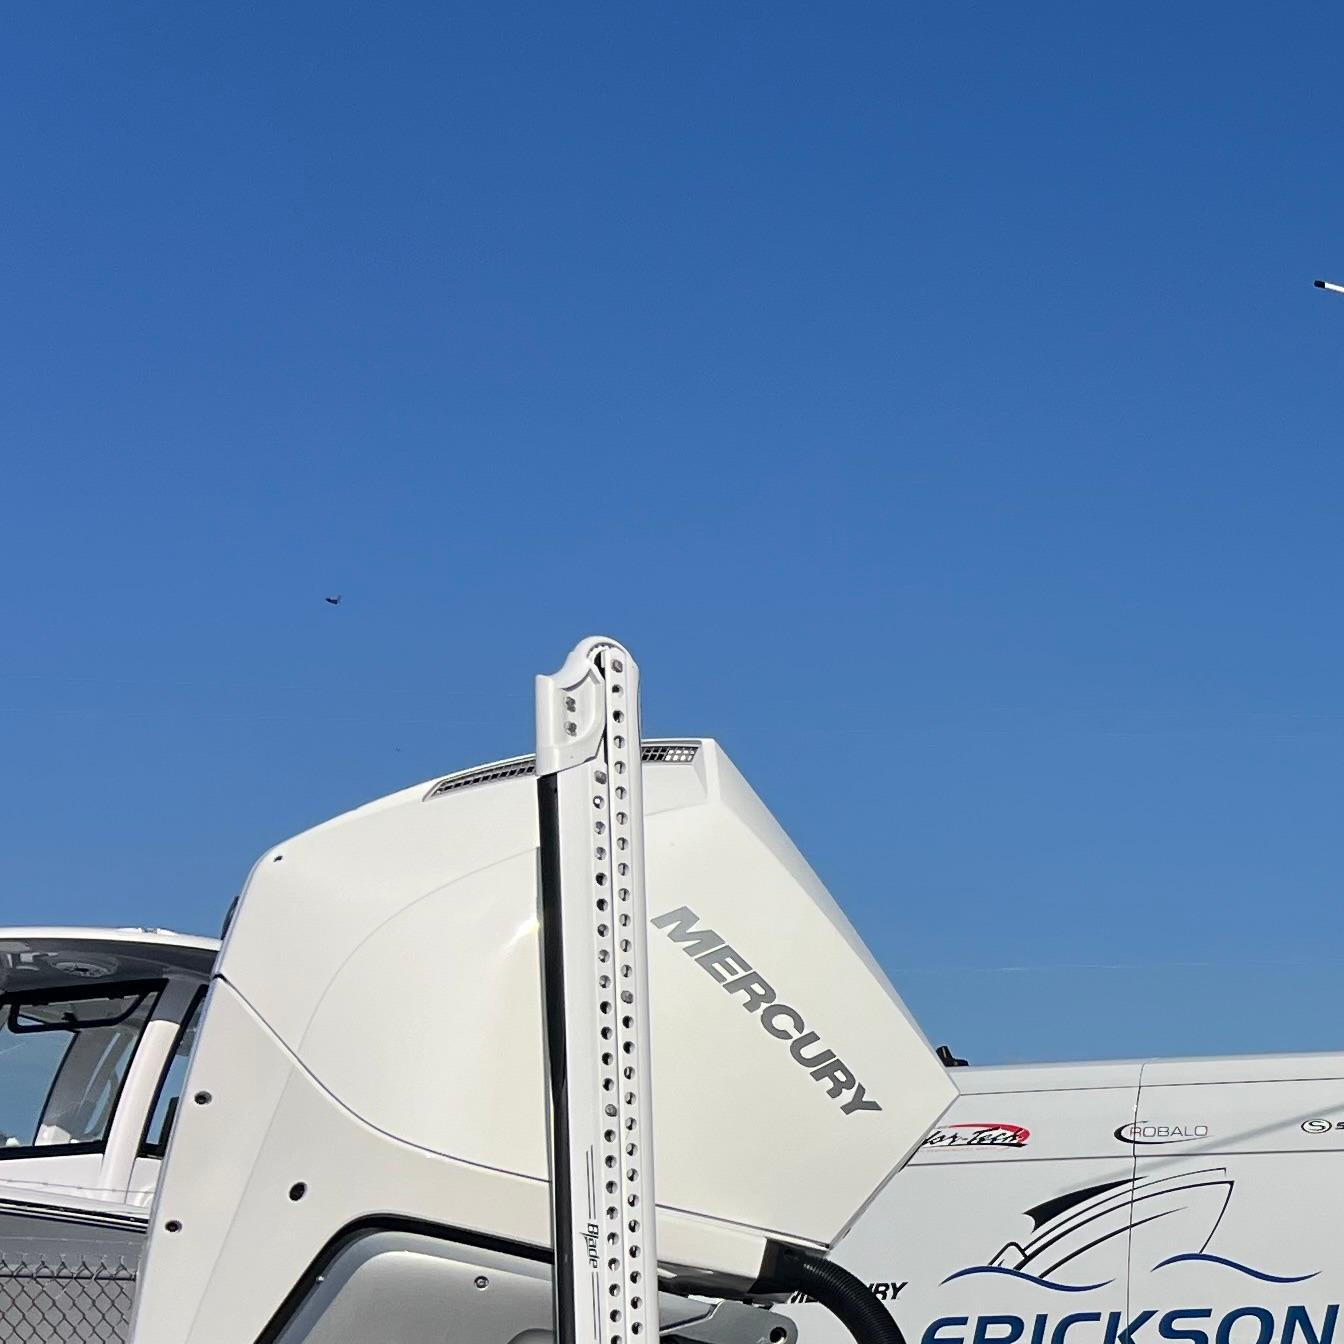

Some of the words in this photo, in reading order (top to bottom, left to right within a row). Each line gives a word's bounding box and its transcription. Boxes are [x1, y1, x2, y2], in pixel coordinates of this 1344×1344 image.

[650, 905, 883, 1116] MERCURY
[1130, 1125, 1208, 1138] ROBALO
[579, 1223, 600, 1269] Blade
